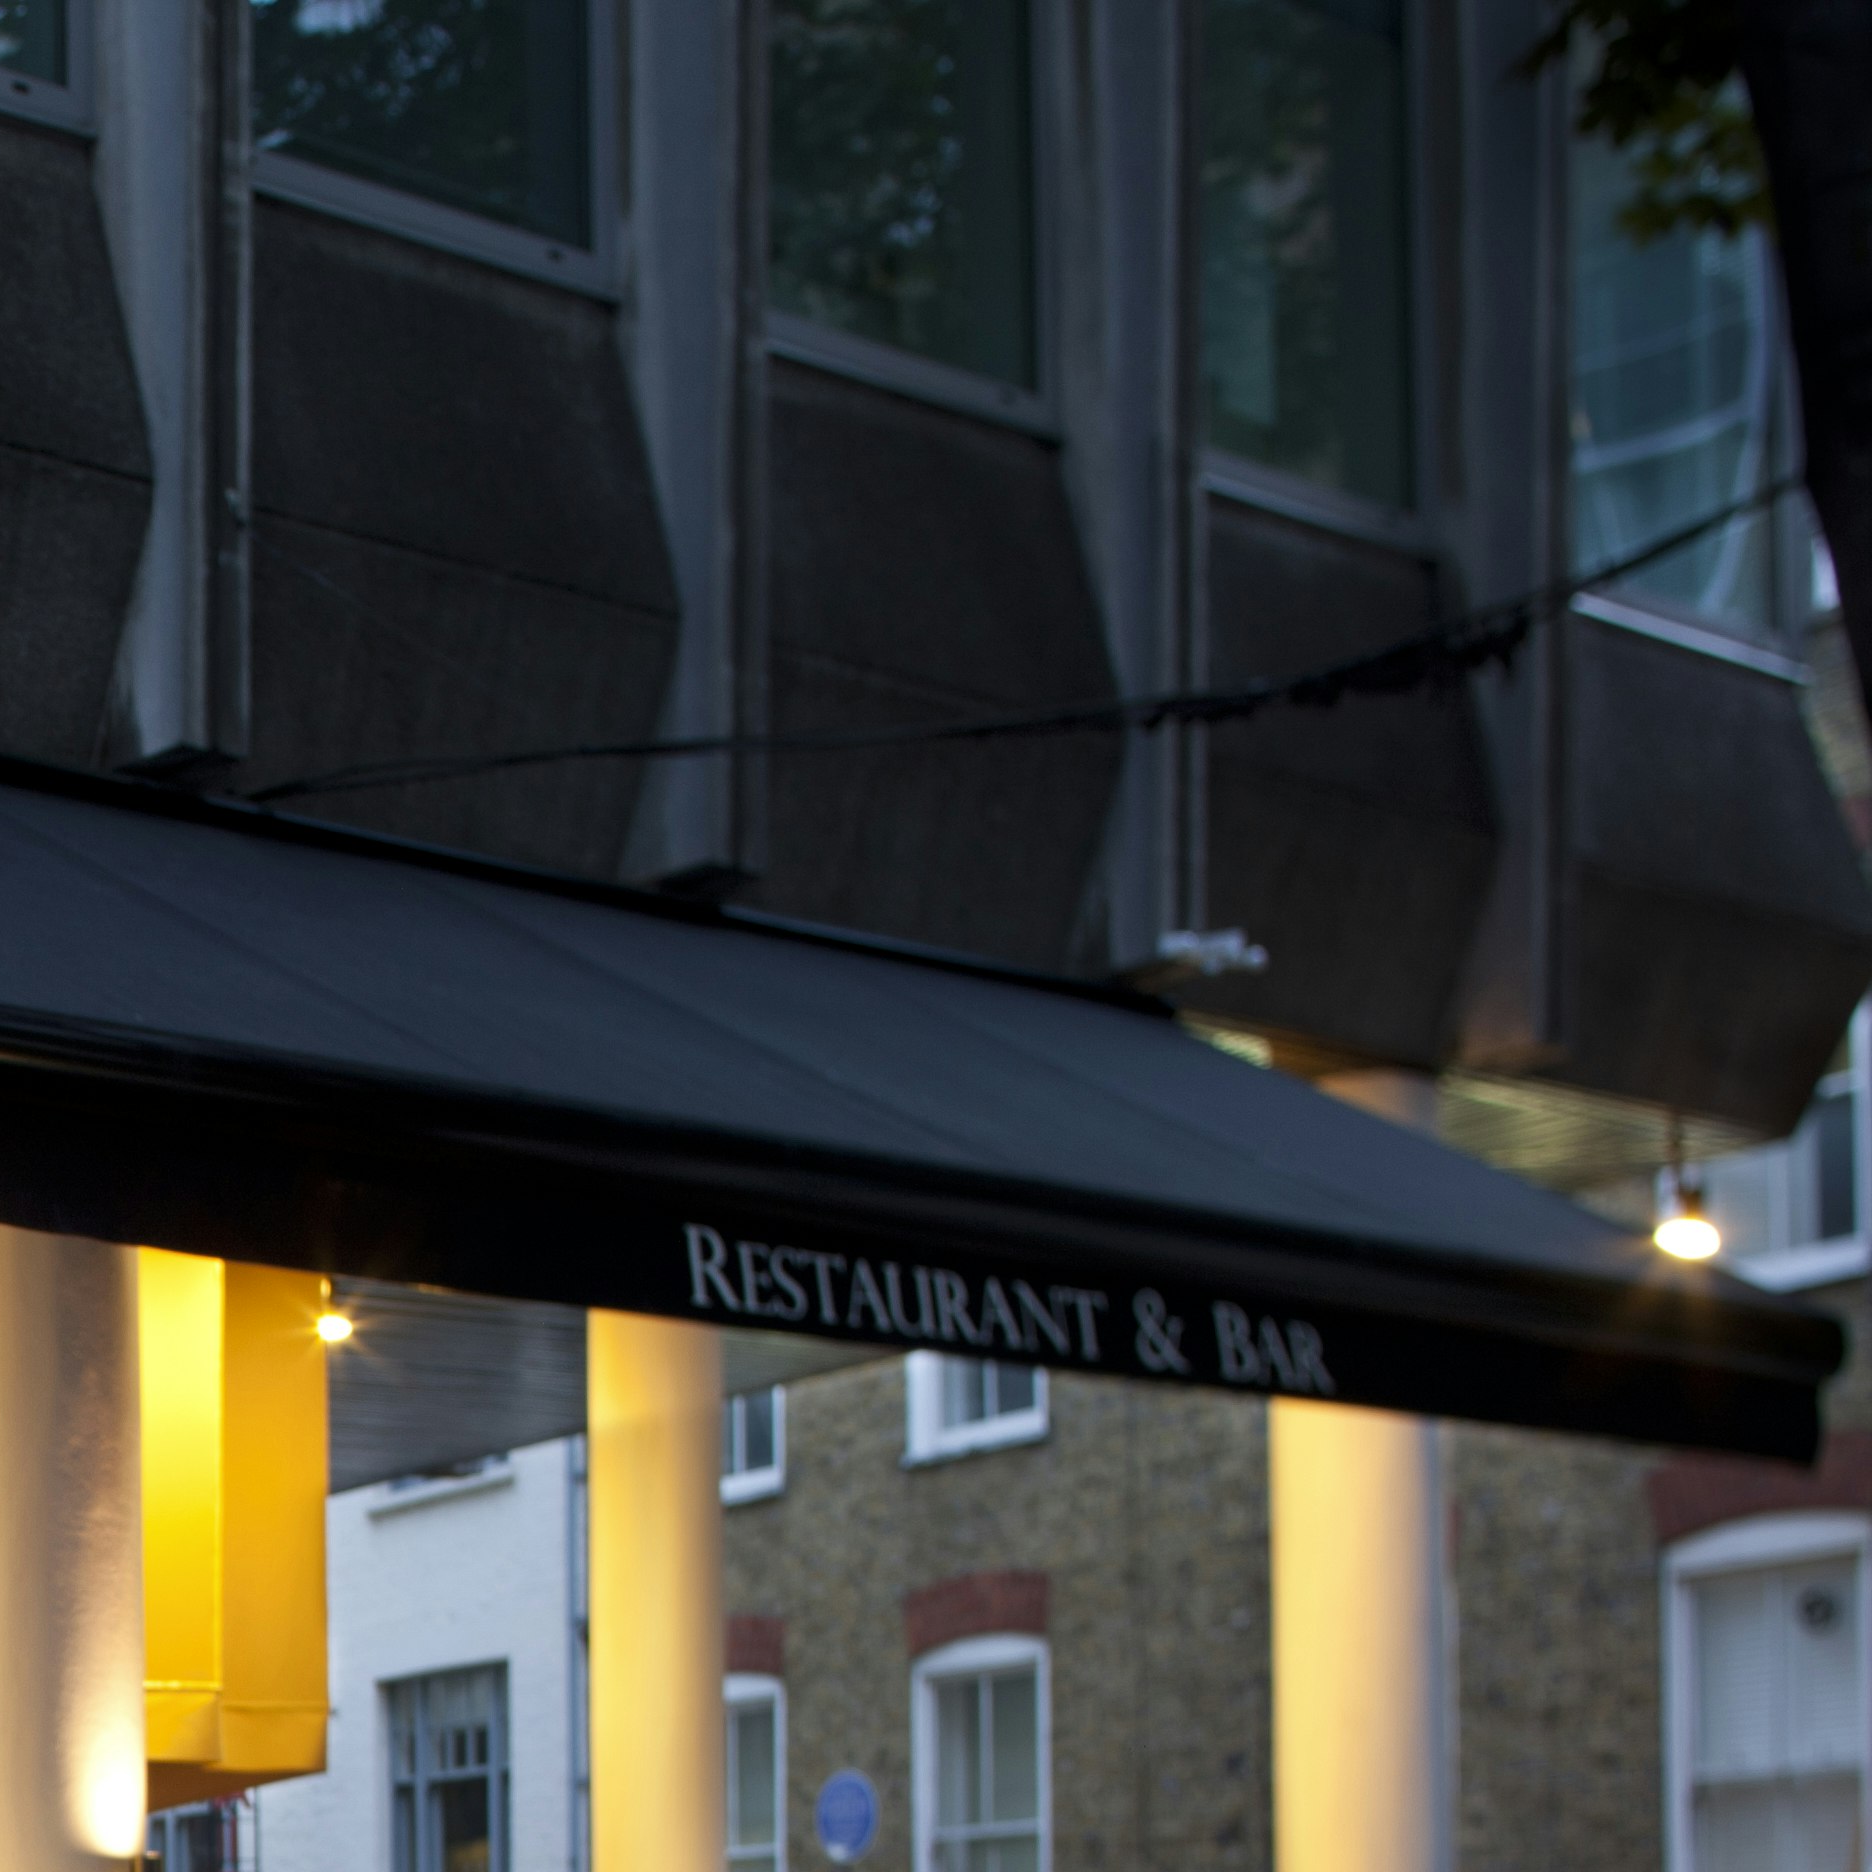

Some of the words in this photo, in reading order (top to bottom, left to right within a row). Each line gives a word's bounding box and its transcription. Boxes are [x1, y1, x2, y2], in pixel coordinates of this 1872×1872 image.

[684, 1222, 1106, 1362] RESTAURANT
[1133, 1287, 1189, 1376] &
[1214, 1299, 1337, 1393] BAR
